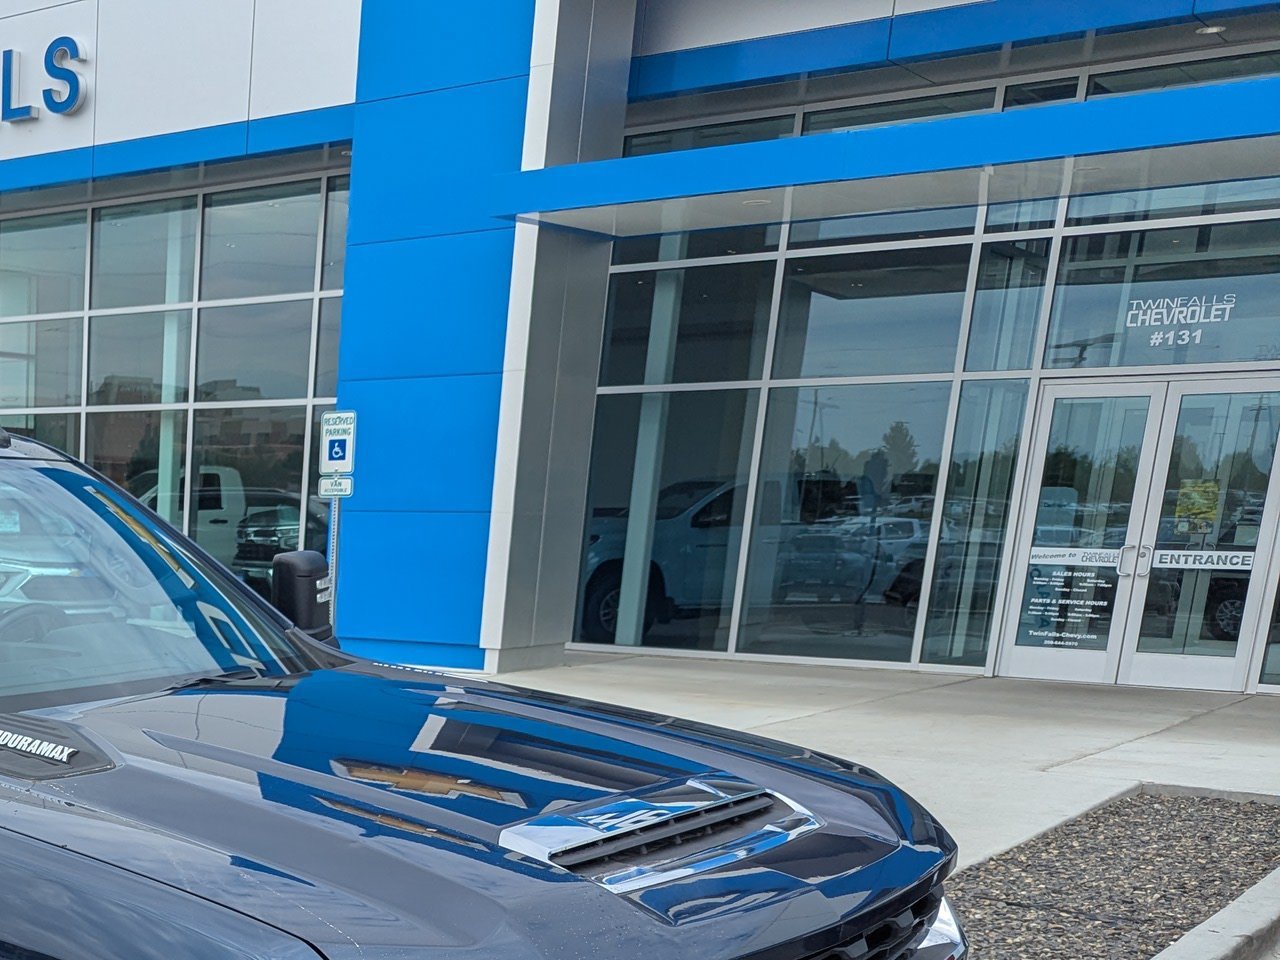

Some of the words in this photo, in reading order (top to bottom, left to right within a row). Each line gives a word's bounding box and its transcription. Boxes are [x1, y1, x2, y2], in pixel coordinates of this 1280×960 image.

[1126, 304, 1235, 328] CHEVROLET
[1149, 329, 1202, 347] #131
[324, 416, 354, 426] RESERVED
[325, 427, 352, 437] PARKING
[1158, 553, 1252, 566] ENTRANCE
